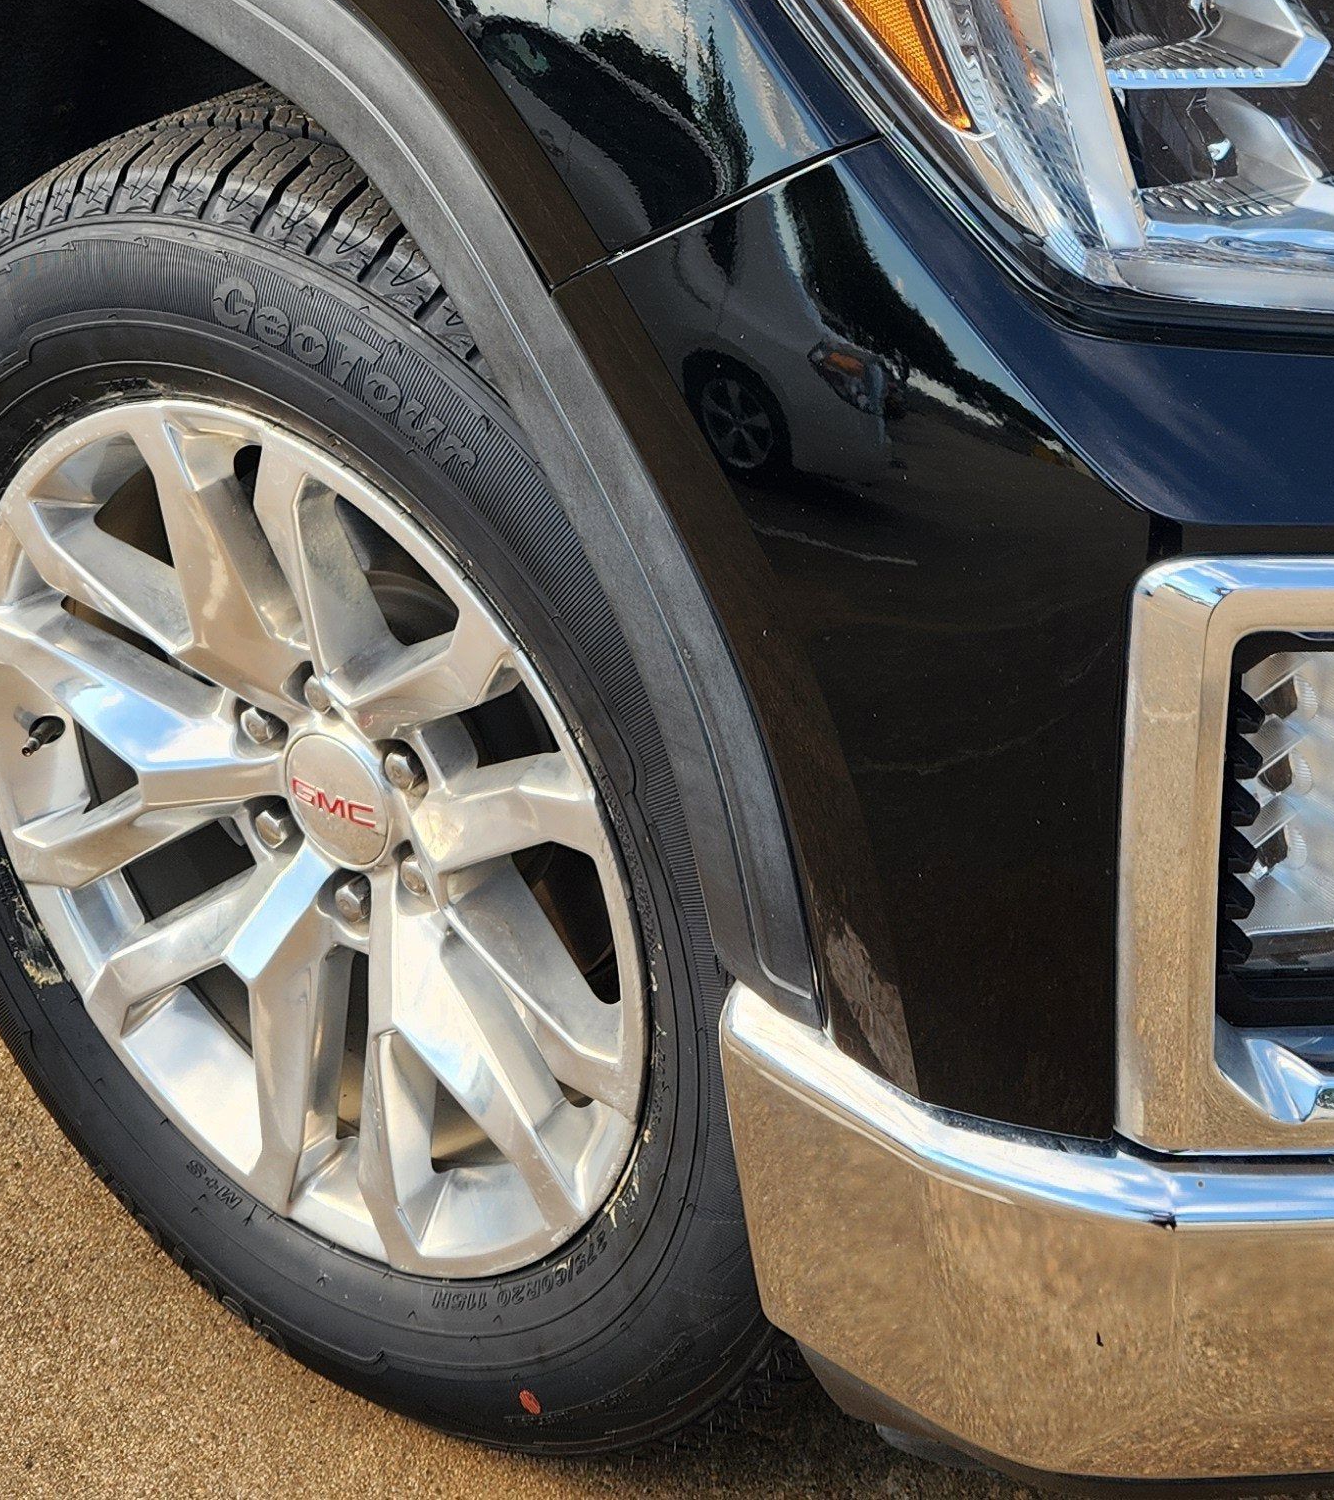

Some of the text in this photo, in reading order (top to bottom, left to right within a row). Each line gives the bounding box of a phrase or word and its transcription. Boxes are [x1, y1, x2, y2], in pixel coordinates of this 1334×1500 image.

[212, 275, 479, 475] GeoTour
[291, 775, 377, 830] GMC
[185, 1157, 244, 1211] M+S
[426, 1289, 492, 1312] 115H
